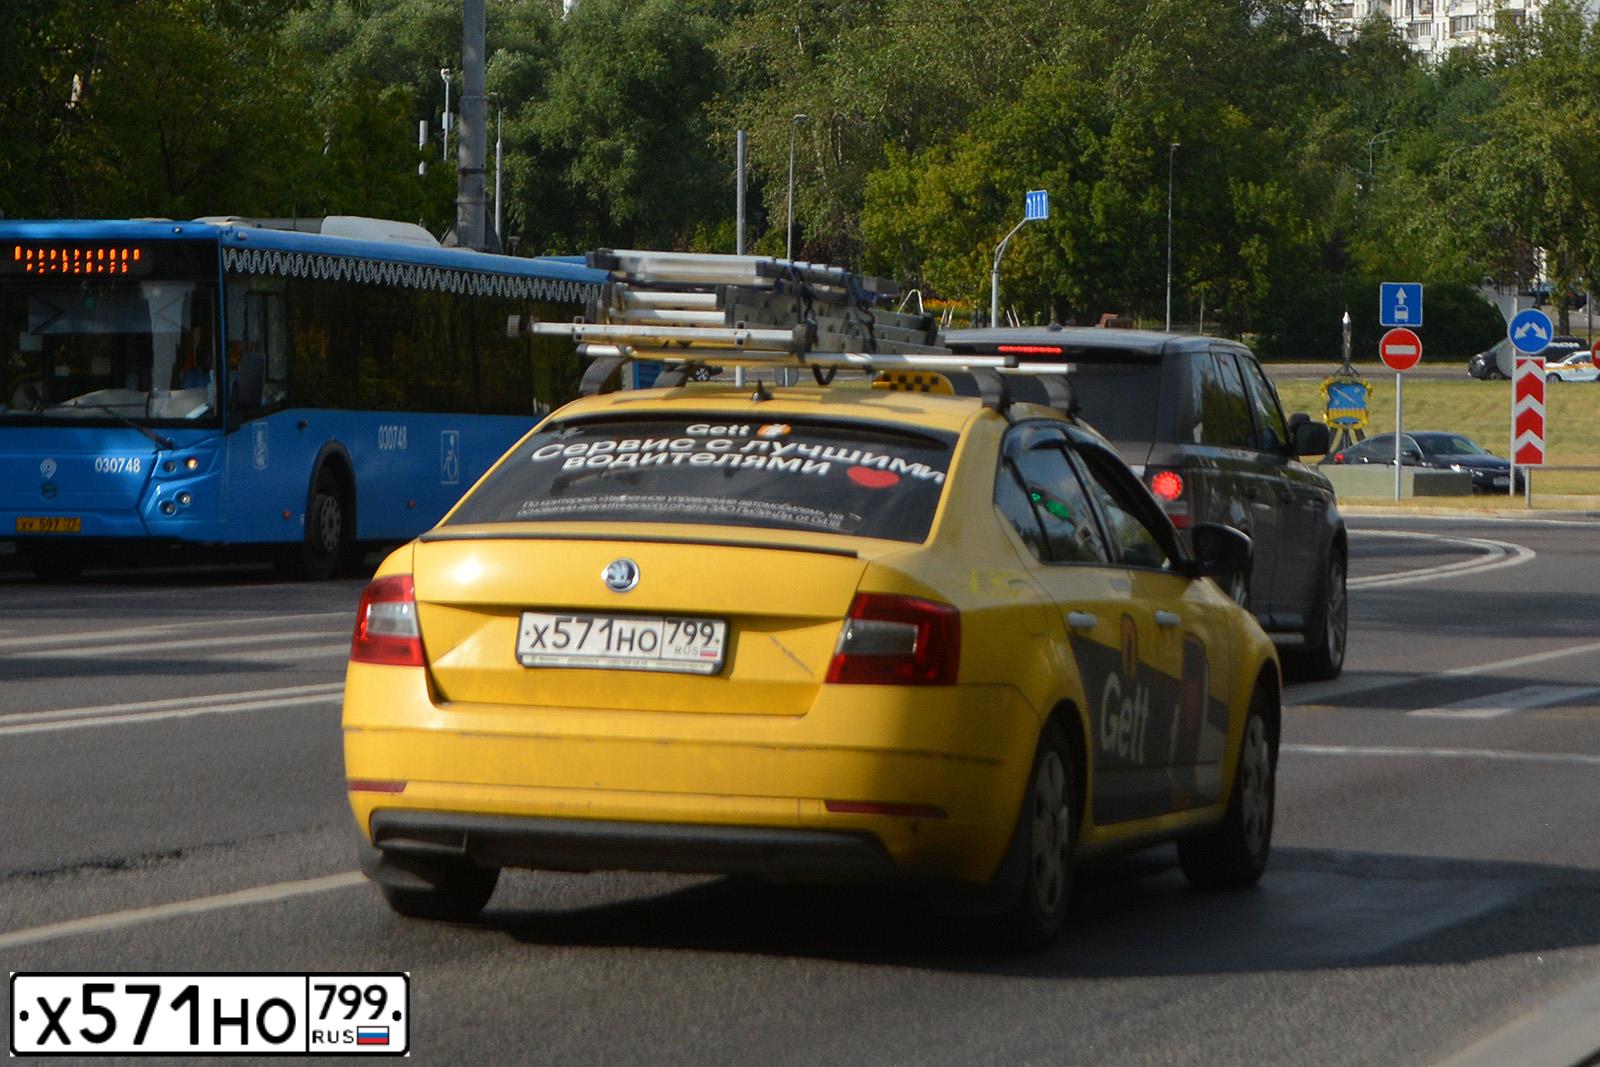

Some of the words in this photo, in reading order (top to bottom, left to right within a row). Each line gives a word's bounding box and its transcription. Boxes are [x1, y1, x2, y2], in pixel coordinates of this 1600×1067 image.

[378, 426, 408, 450] 030748
[686, 424, 750, 436] Gett
[94, 456, 141, 473] 030748
[531, 438, 697, 462] Сервис
[705, 438, 733, 451] с
[739, 439, 945, 485] лучшими
[562, 452, 831, 477] водителями
[530, 617, 658, 652] Х571НО
[666, 619, 715, 647] 799
[674, 646, 698, 656] RUS
[1102, 671, 1149, 765] Gett
